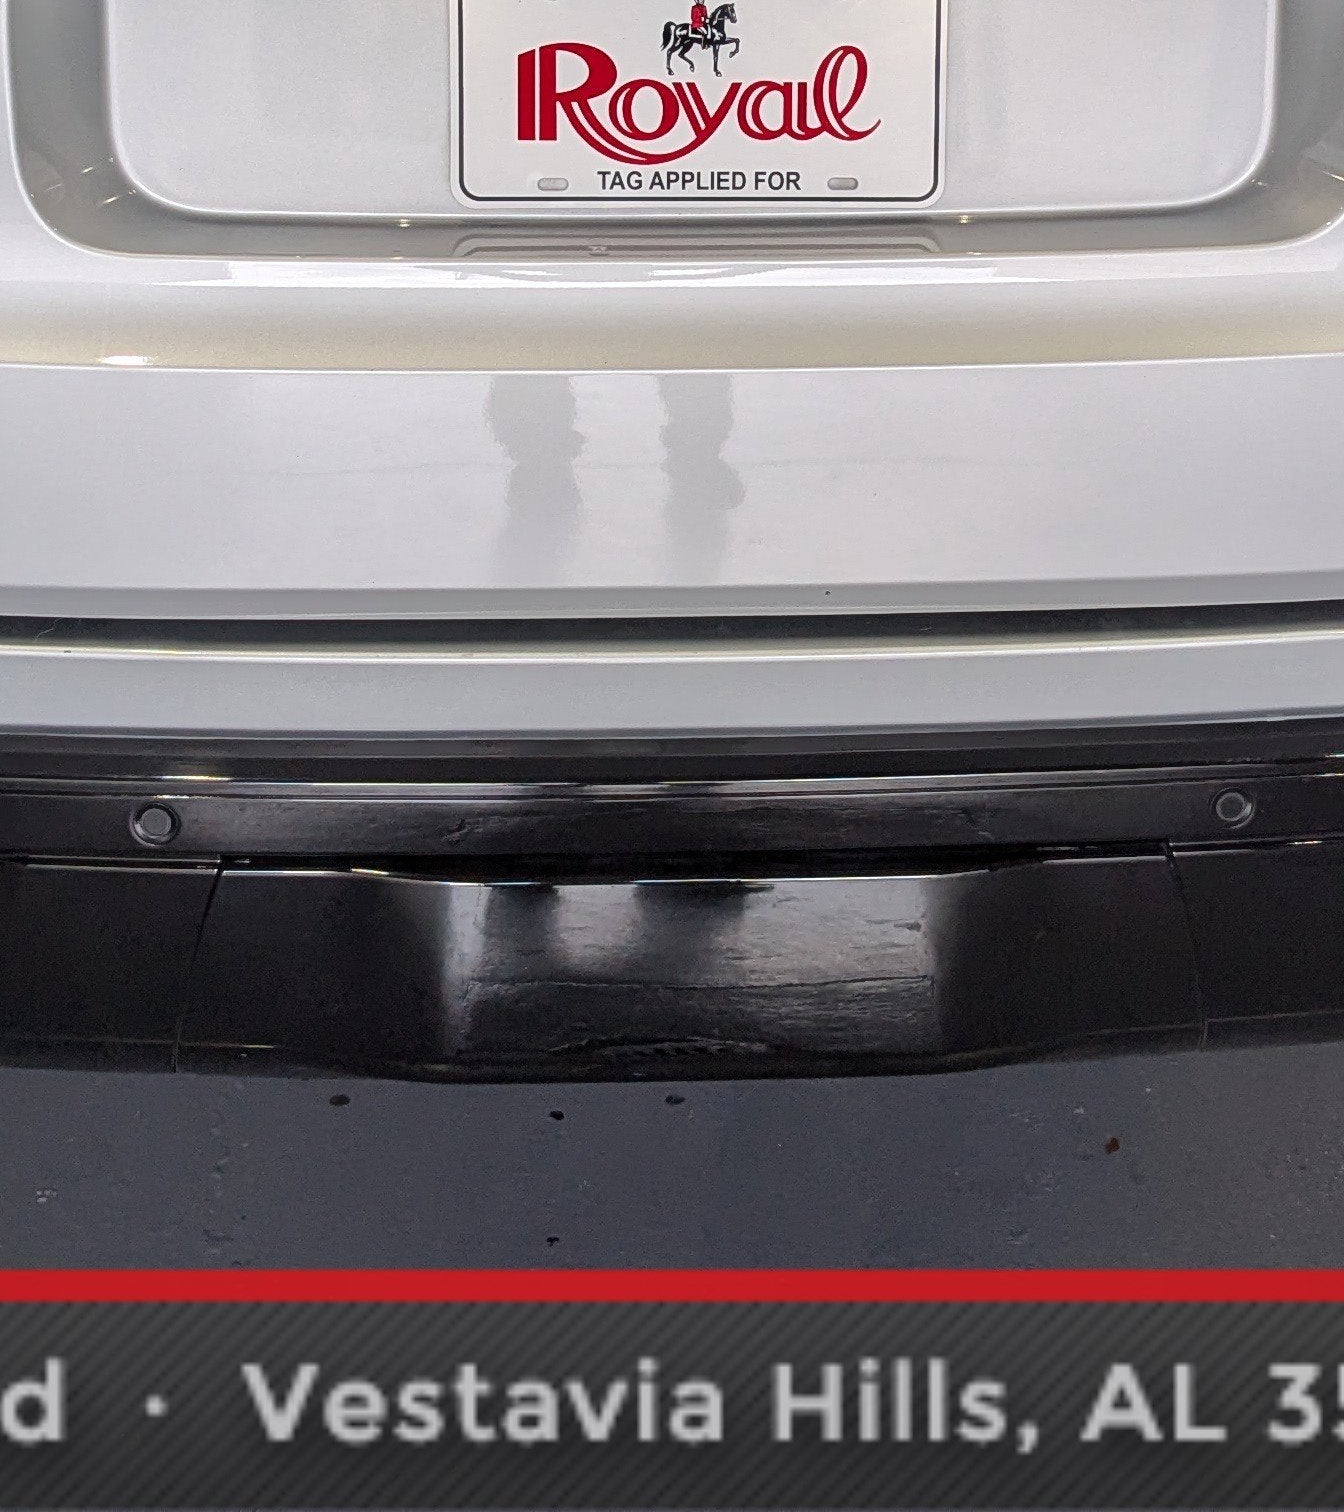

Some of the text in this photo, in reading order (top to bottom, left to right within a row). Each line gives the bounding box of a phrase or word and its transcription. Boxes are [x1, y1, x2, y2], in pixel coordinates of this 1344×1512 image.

[517, 42, 882, 166] Royal
[597, 170, 802, 191] TAG APPLIED FOR
